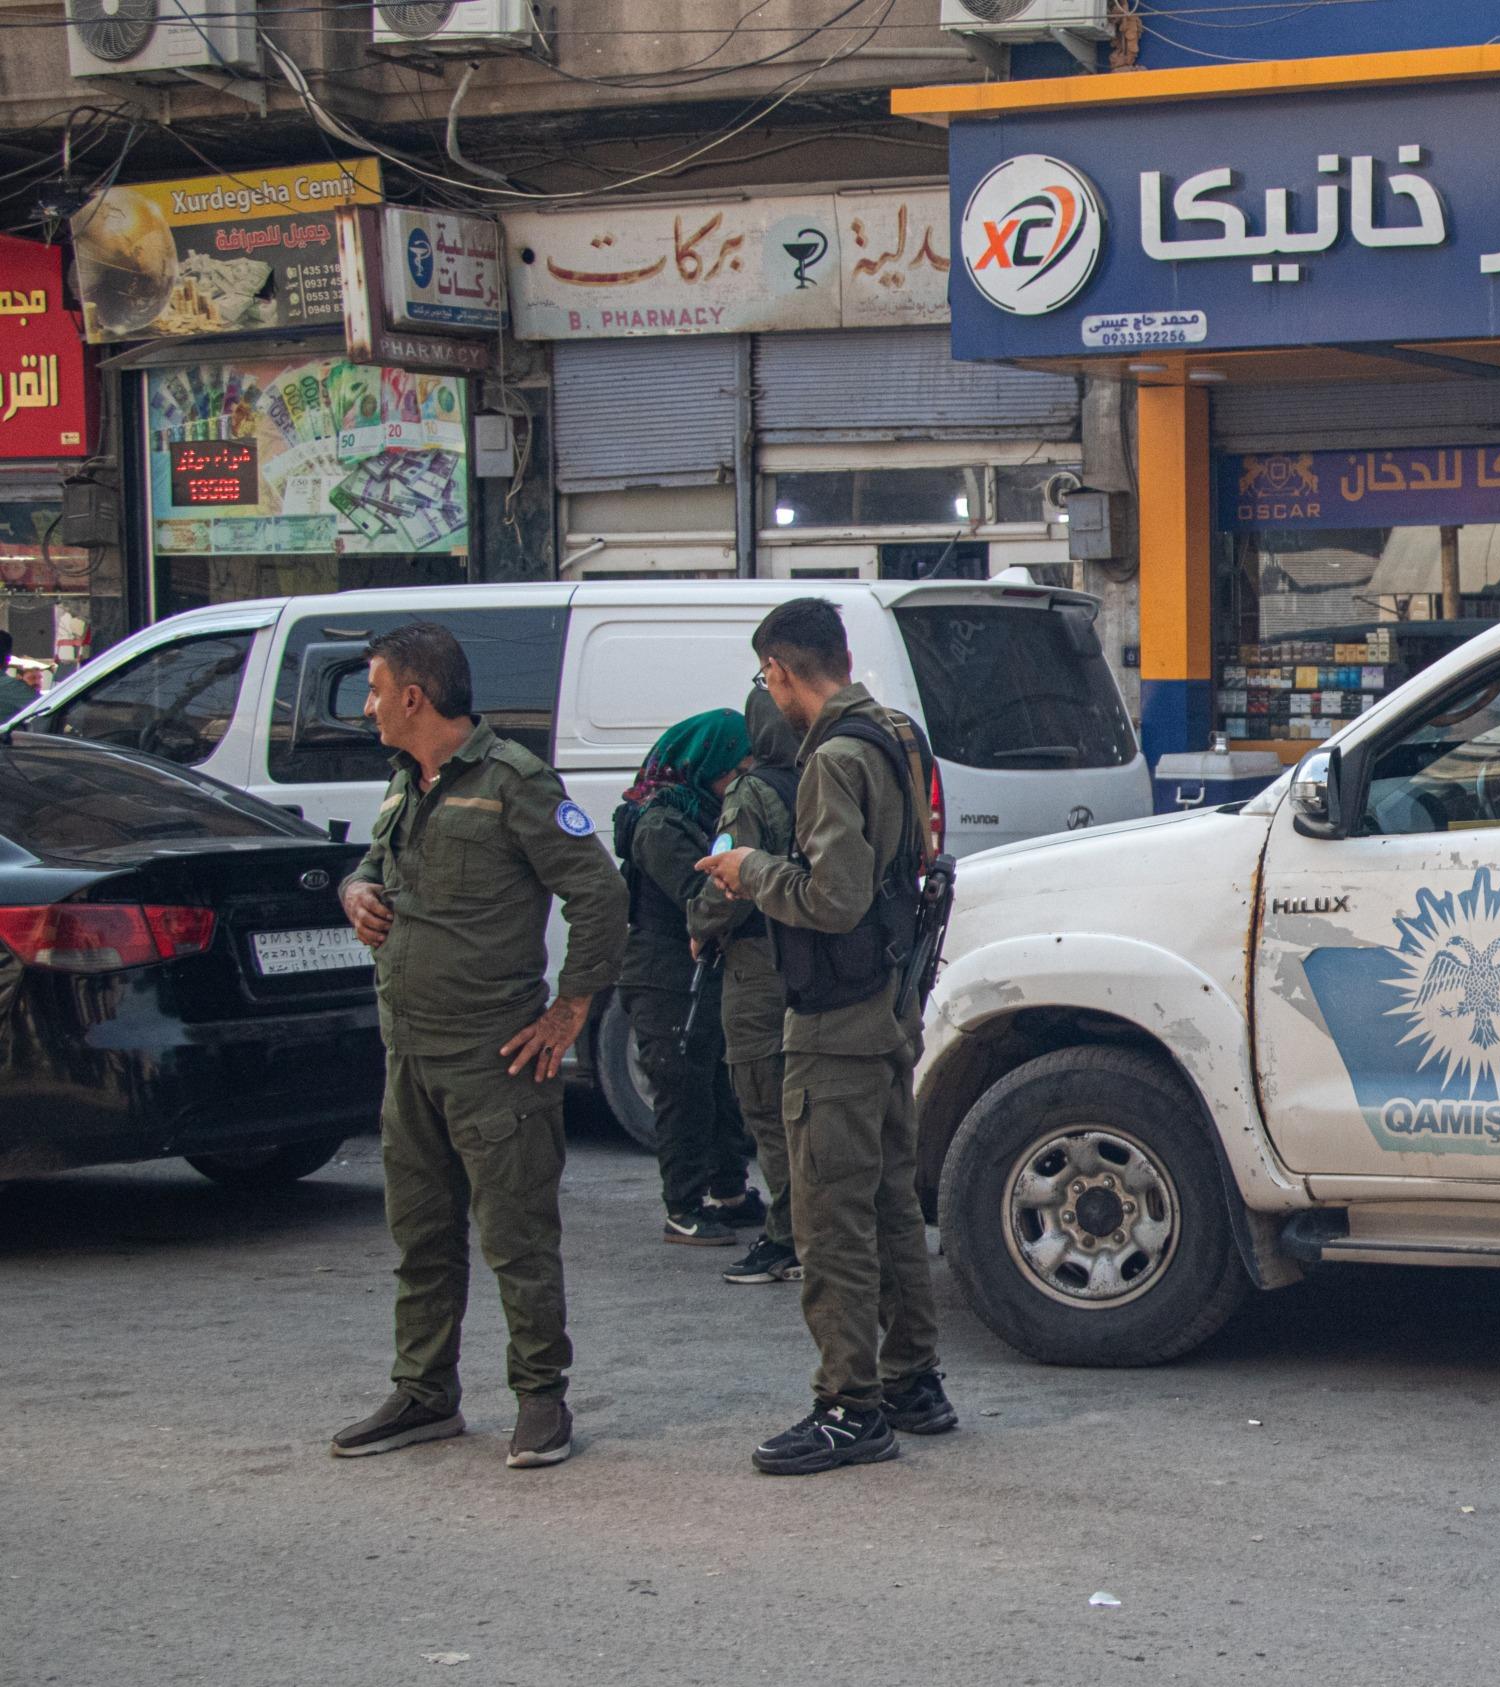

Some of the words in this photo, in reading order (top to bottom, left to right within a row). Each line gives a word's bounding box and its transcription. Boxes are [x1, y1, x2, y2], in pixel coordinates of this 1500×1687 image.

[171, 181, 290, 214] Xurdegeha
[1140, 144, 1447, 282] خانيكا
[215, 225, 282, 252] للصرافة
[284, 223, 331, 248] جميل
[547, 210, 747, 286] بركات
[601, 306, 726, 329] PHARMACY
[1133, 314, 1157, 331] حاج
[1160, 314, 1200, 326] محمد
[1101, 331, 1187, 345] 0933322256
[380, 339, 481, 363] PHARMACY
[1341, 450, 1463, 502] للدخان
[1238, 503, 1322, 521] OSCAR
[960, 814, 1000, 825] HYUNDAI
